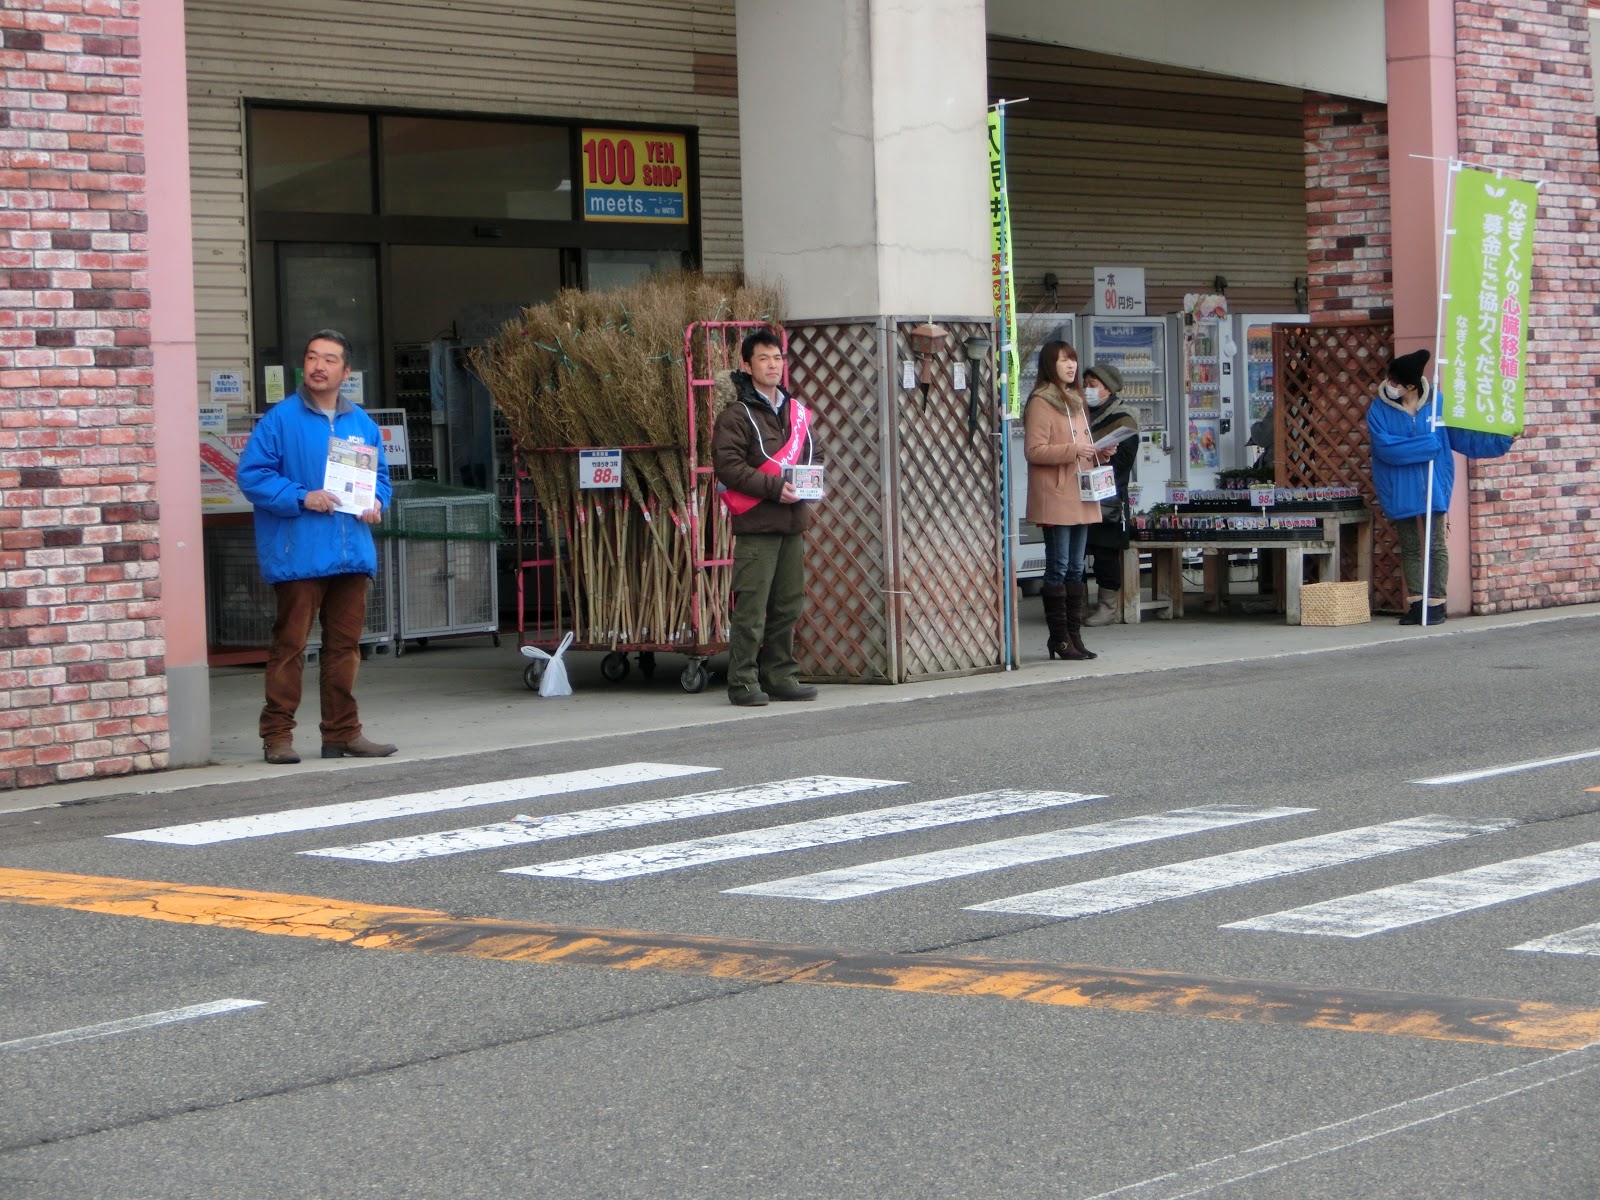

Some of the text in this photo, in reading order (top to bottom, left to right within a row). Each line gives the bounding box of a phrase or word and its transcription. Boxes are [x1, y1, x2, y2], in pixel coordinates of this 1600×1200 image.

[583, 138, 675, 185] 100 YEN
[642, 164, 682, 187] SHOP
[1098, 273, 1116, 287] 一本
[1475, 213, 1504, 424] 募金にご協力ください。
[1499, 199, 1528, 425] なぎくんの心臓移植のため
[593, 468, 619, 484] 88円
